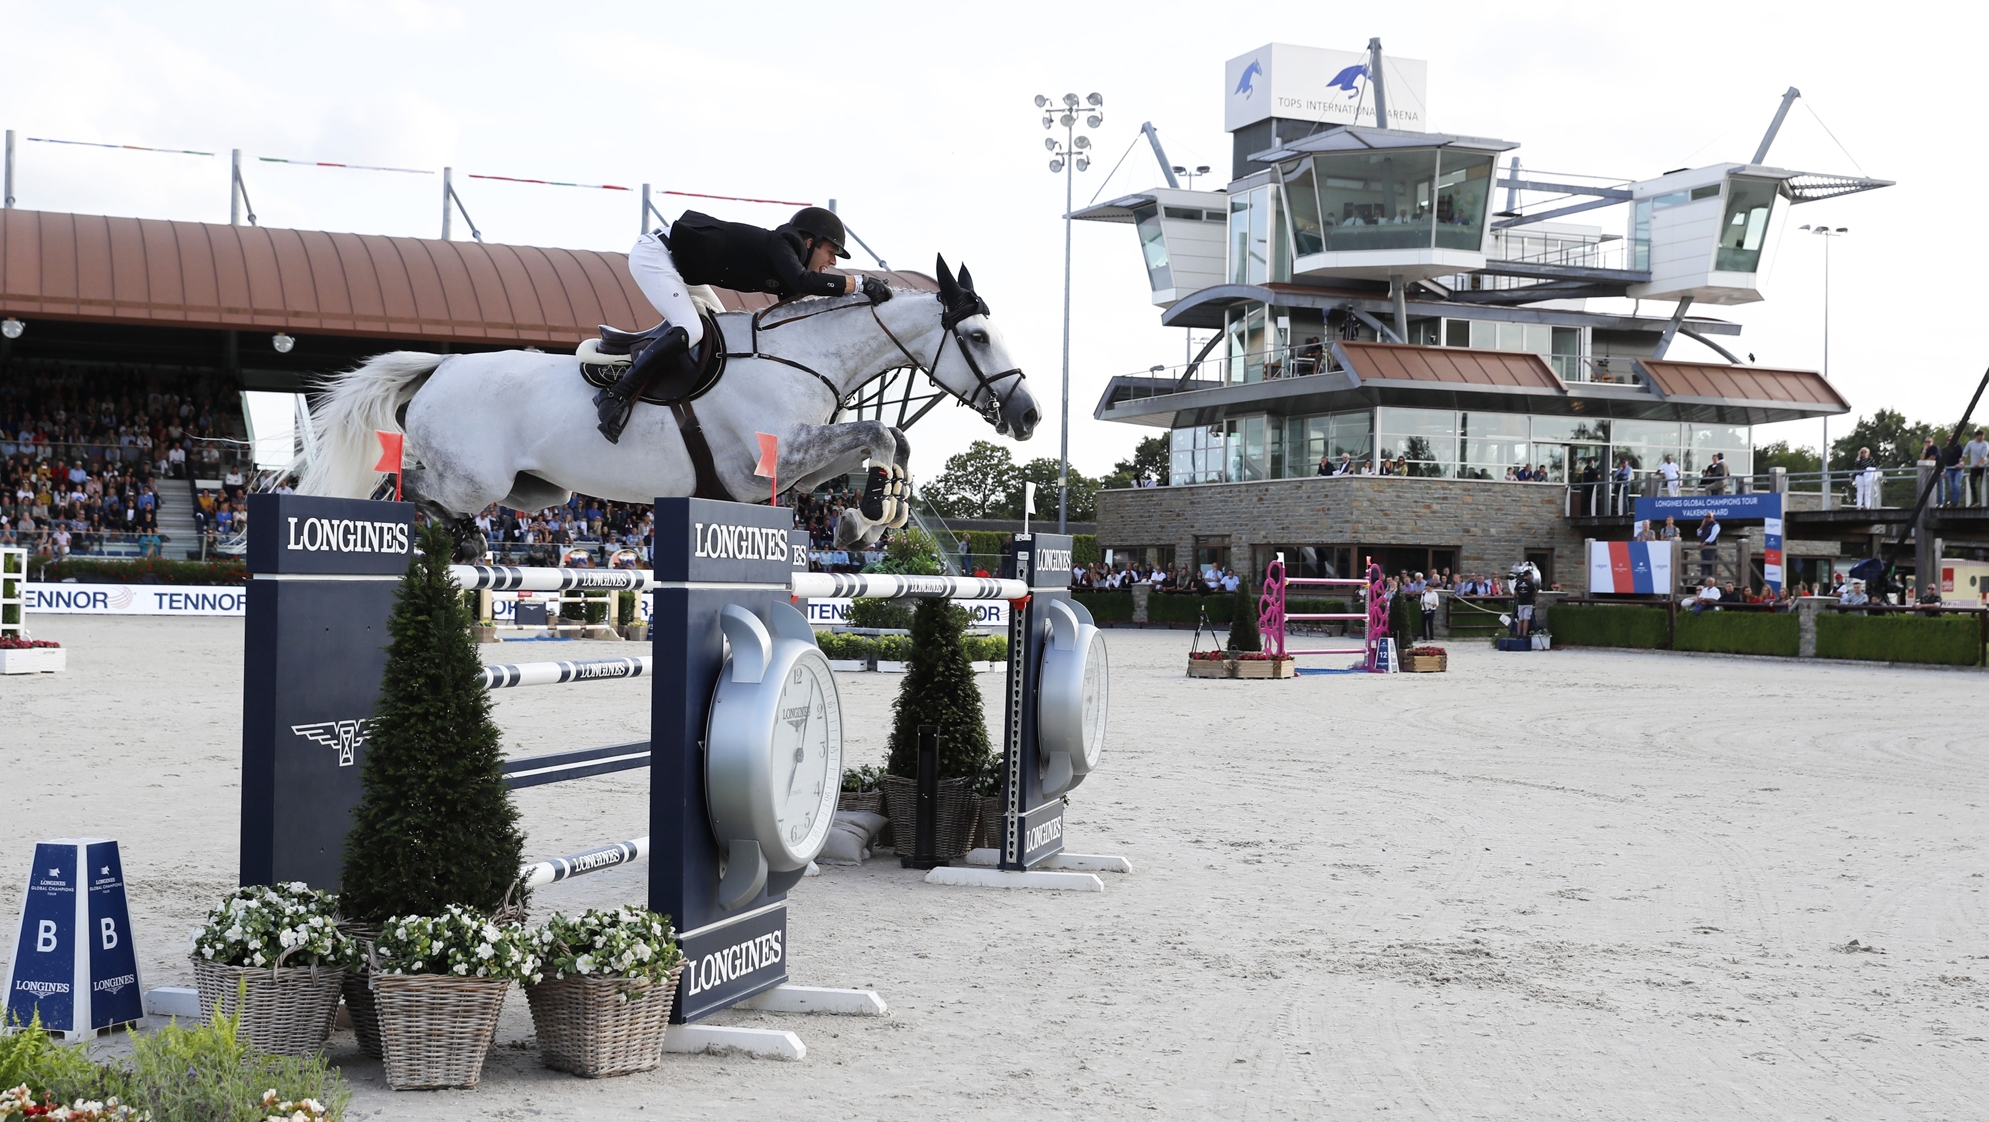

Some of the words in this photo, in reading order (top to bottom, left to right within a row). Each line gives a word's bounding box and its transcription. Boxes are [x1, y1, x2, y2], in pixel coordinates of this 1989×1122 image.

[1278, 97, 1302, 109] TOPS
[1306, 101, 1377, 117] INTERNATIONA
[1386, 109, 1419, 121] ARENA
[1655, 499, 1682, 508] LONGINES
[1684, 499, 1705, 507] GLOBAL
[1706, 498, 1741, 507] CHAMPIONS
[1742, 497, 1758, 505] TOUR
[287, 517, 409, 555] LONGINES
[695, 522, 788, 562] LONGINES
[1036, 548, 1072, 572] LONGINES
[582, 572, 627, 588] LONGINES
[910, 577, 944, 593] LONGINES
[25, 590, 108, 609] ENNOR
[580, 661, 626, 679] LONGINES
[794, 668, 802, 684] 12
[782, 706, 811, 720] LONGINES
[817, 703, 823, 719] 2
[819, 741, 826, 758] 3
[813, 781, 820, 797] 4
[804, 811, 811, 829] 5
[790, 825, 797, 842] 6
[1026, 816, 1061, 853] LONGINES
[572, 848, 620, 872] LONGINES
[95, 877, 116, 885] LONGINES
[103, 882, 123, 890] CHAMPIONS
[36, 919, 58, 953] B
[100, 917, 118, 950] B
[688, 929, 782, 997] LONGINES
[16, 980, 70, 993] LONGINES
[93, 974, 135, 992] LONGINES
